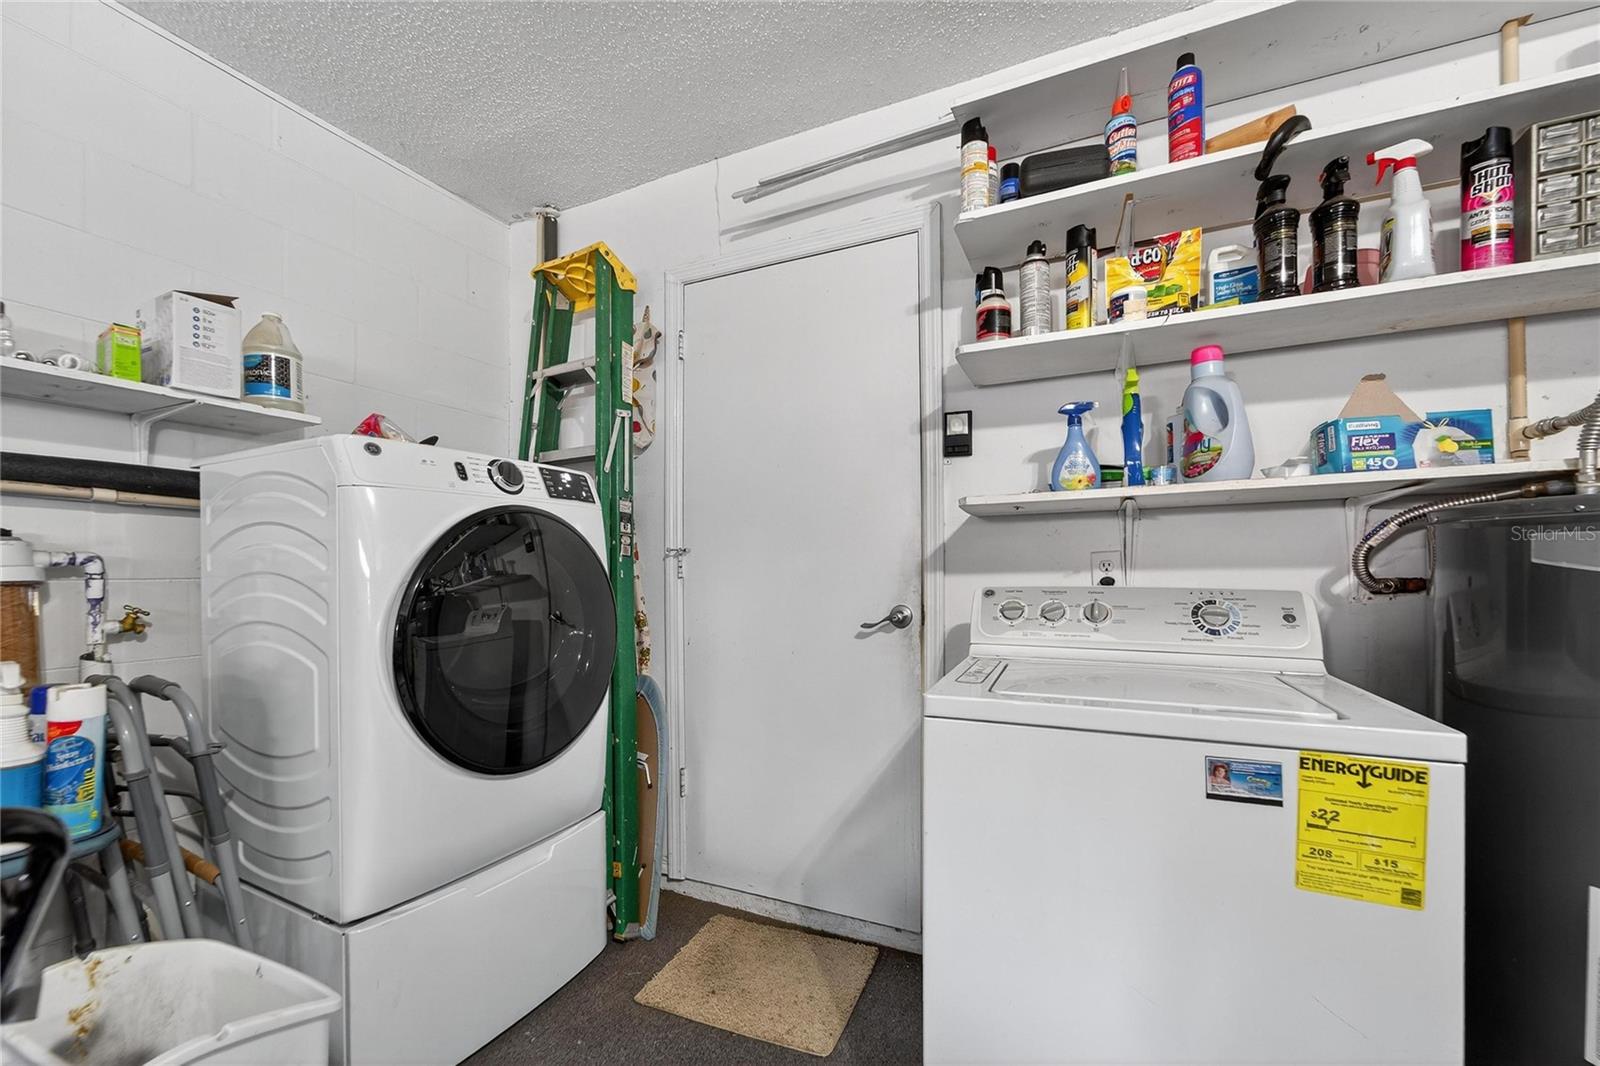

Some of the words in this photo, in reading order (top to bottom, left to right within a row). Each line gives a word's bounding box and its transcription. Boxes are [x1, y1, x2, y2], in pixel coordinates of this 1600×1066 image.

[1475, 163, 1510, 183] HOT
[1471, 174, 1512, 197] SHOT
[1131, 247, 1163, 266] d-CO
[1351, 436, 1380, 447] Flex
[1366, 457, 1382, 466] 45
[1300, 756, 1428, 785] ENERGYGUIDE
[1310, 808, 1340, 823] $22
